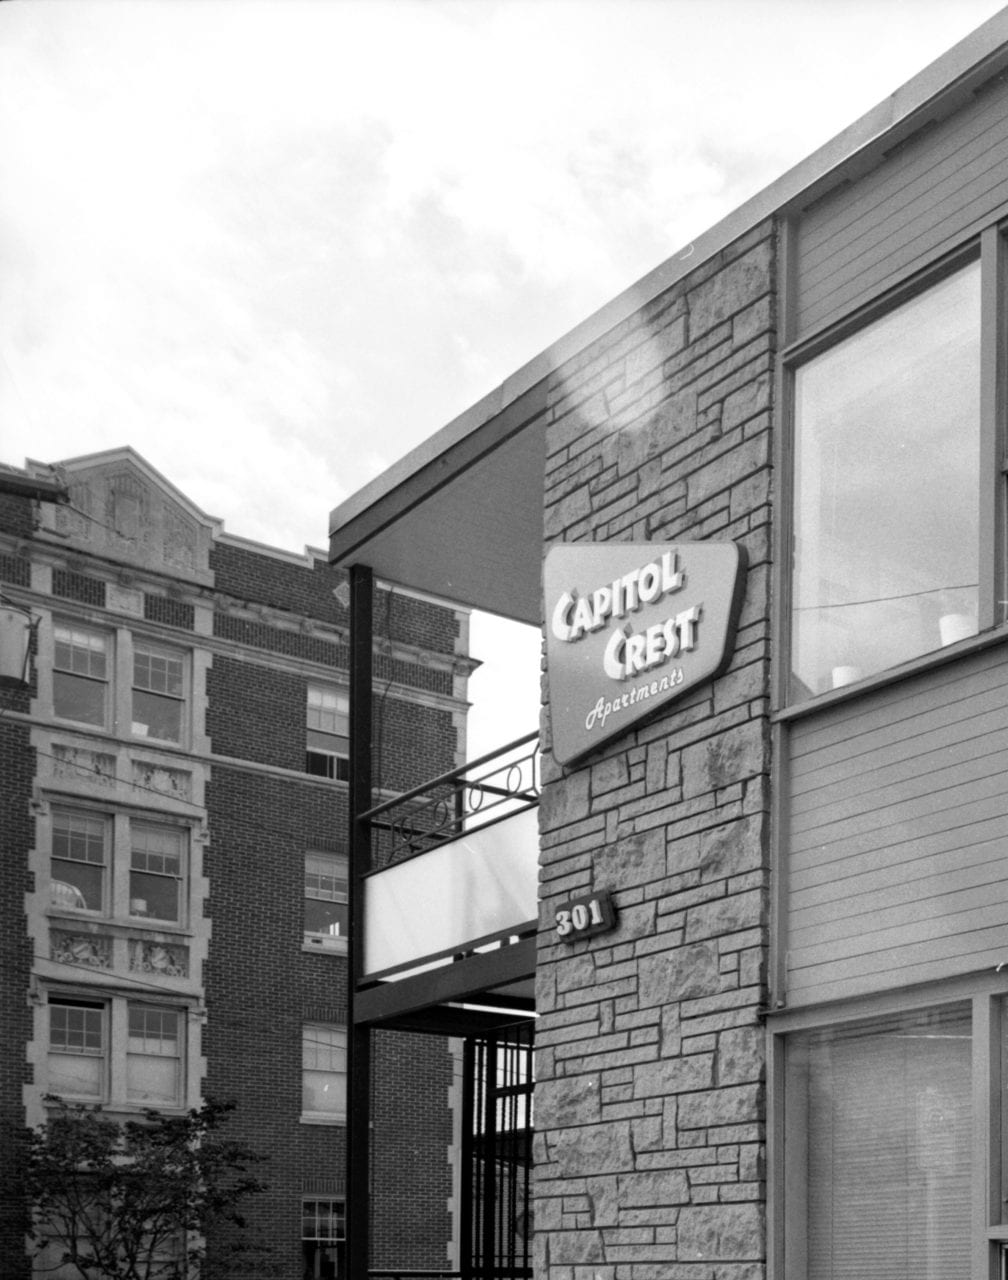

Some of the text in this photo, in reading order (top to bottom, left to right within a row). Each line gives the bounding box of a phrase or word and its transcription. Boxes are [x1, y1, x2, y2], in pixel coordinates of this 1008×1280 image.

[551, 551, 684, 642] CAPITOL
[603, 606, 700, 680] CREST
[585, 668, 684, 730] Apartments
[556, 900, 604, 936] 301
